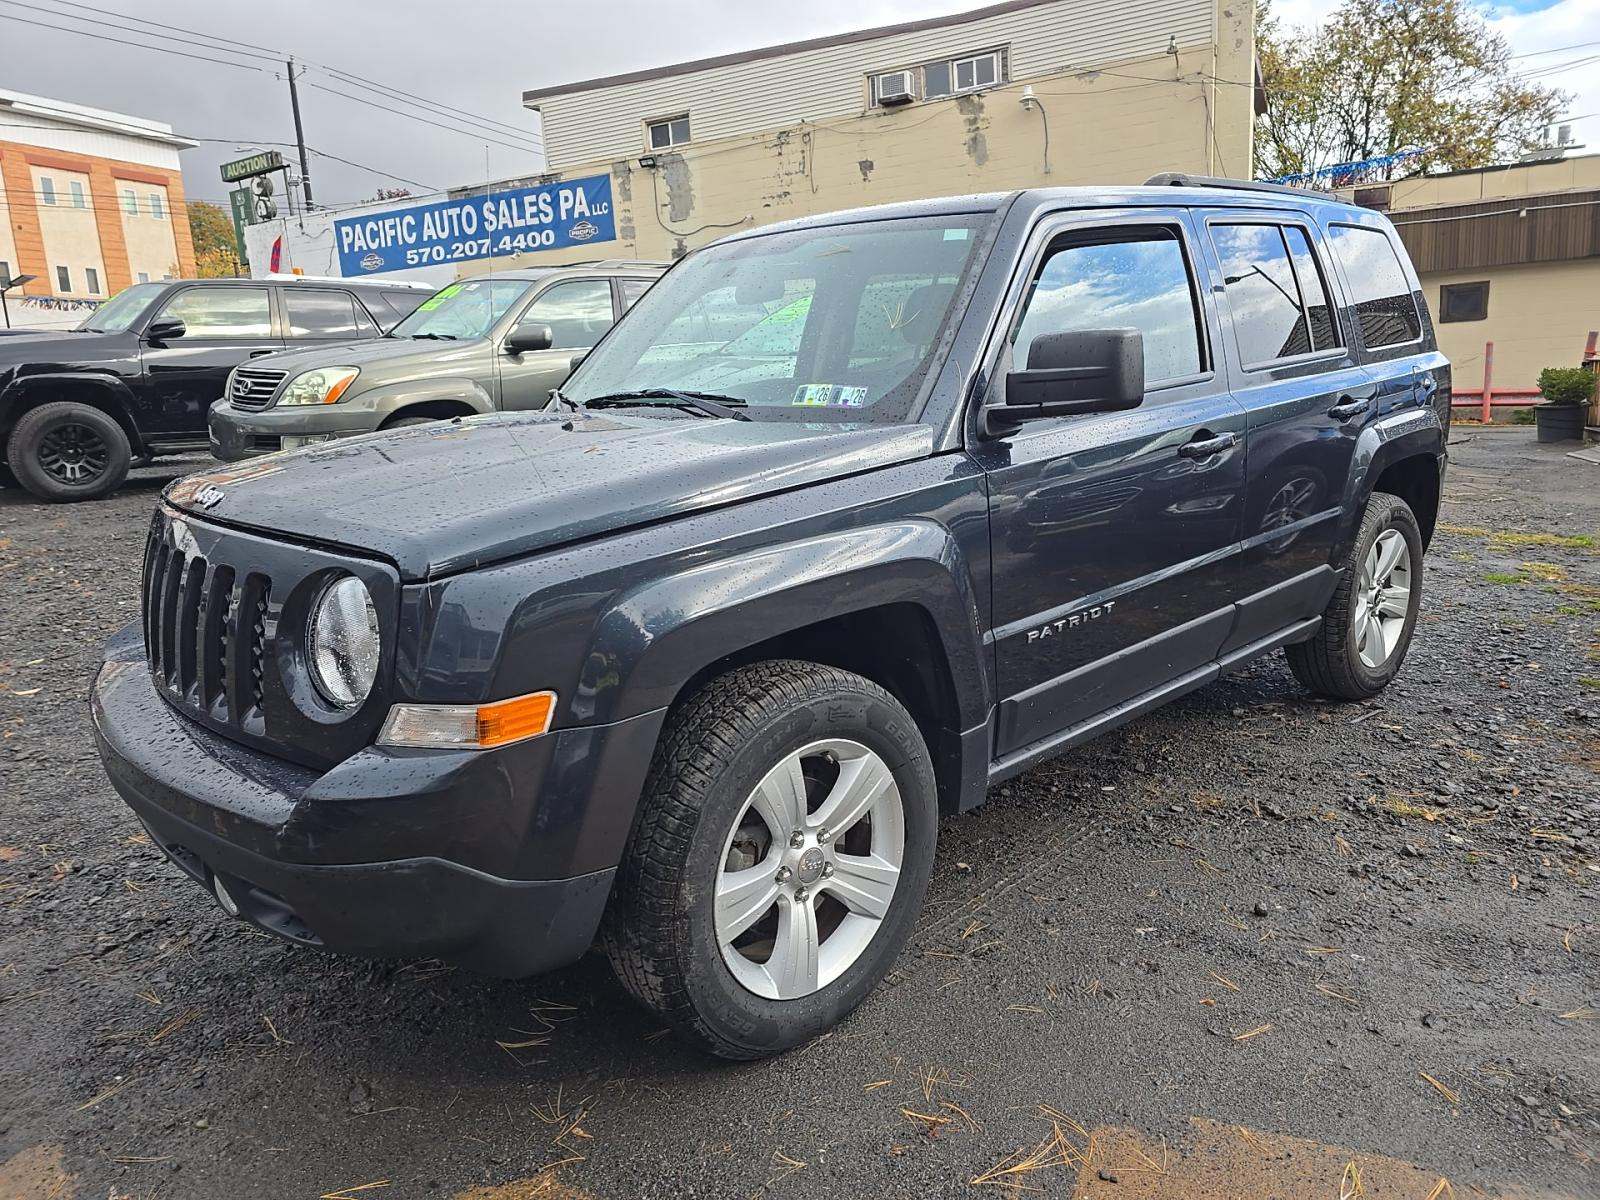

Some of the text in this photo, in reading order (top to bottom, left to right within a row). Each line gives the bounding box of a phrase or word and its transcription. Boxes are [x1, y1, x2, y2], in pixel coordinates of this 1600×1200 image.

[226, 156, 268, 178] AUCTION
[341, 187, 609, 254] PACIFIC AUTO SALES PA LLC
[406, 230, 555, 265] 570.207.4400
[1026, 601, 1116, 644] PATRIOT
